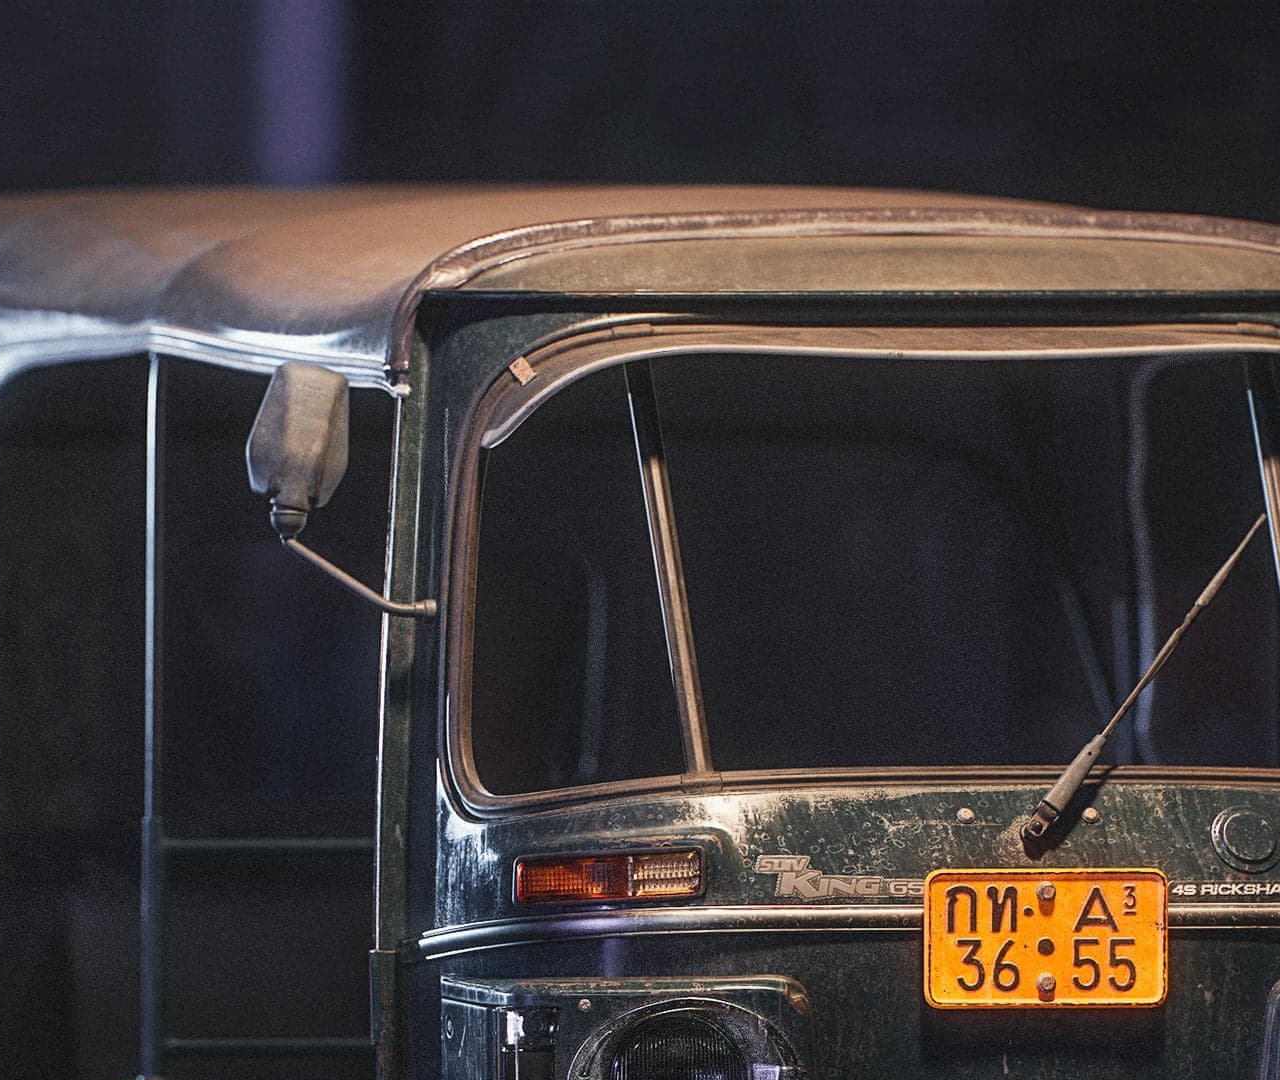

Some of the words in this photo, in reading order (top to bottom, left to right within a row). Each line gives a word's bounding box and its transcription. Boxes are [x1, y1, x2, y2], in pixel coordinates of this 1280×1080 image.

[1171, 883, 1197, 895] 4S
[956, 938, 1020, 992] 36
[1072, 938, 1136, 992] 55
